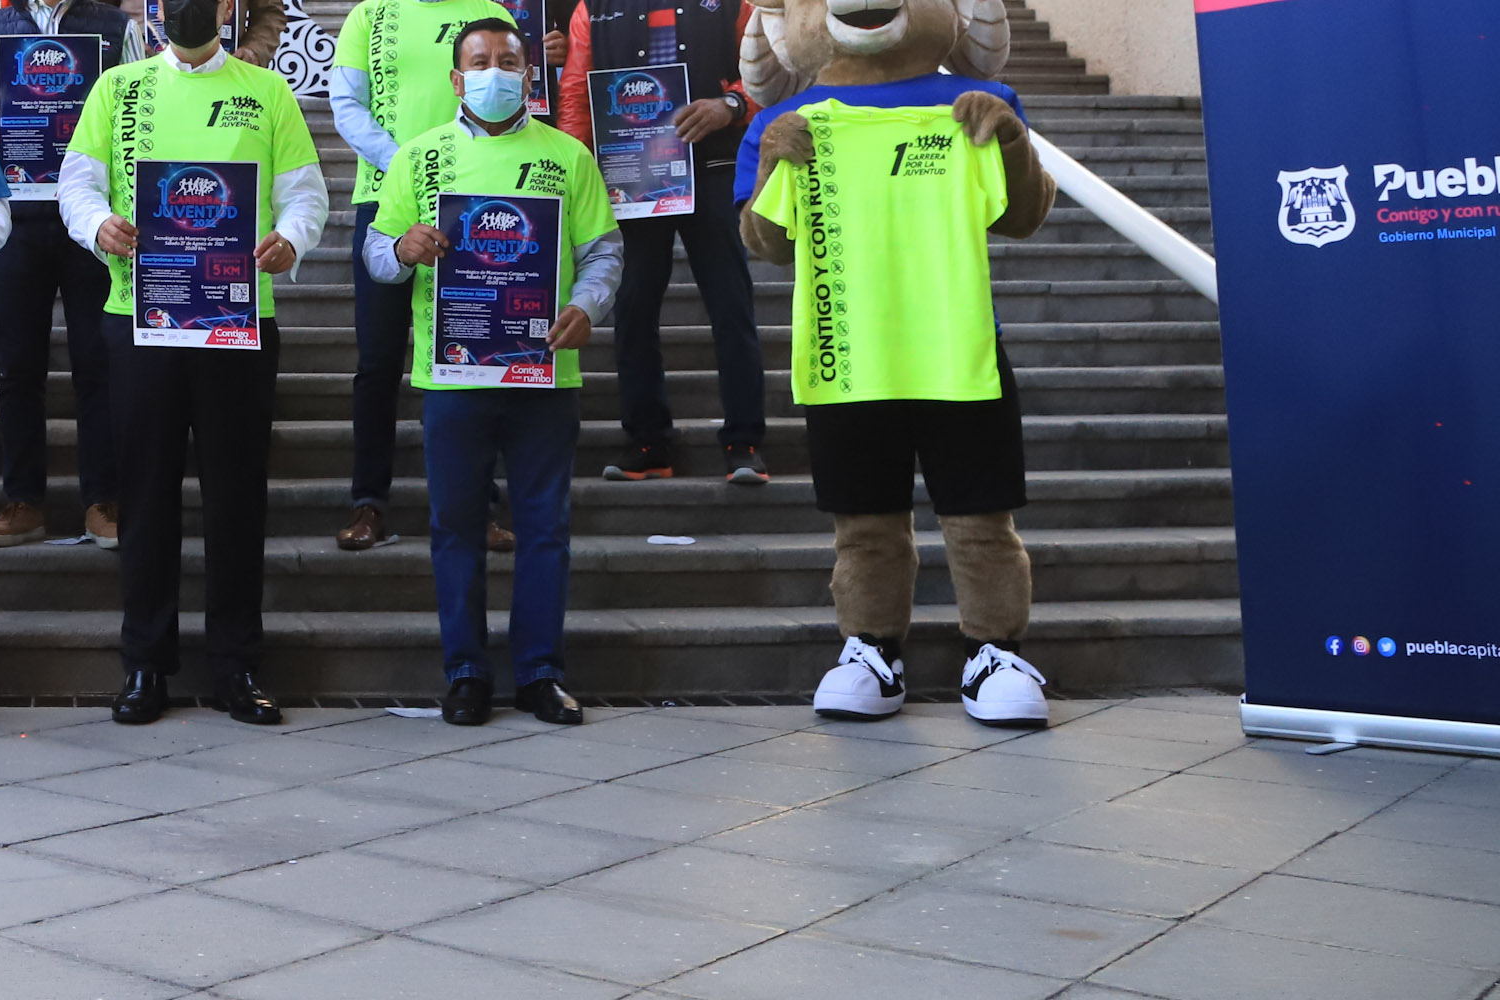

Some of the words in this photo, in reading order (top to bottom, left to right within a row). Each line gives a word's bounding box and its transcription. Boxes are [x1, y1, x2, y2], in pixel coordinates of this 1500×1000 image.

[11, 74, 84, 85] JUVENTUD
[373, 59, 384, 95] CON
[376, 99, 385, 110] Y
[607, 101, 673, 115] JUVENTUD
[223, 110, 259, 119] CARRERA
[220, 122, 260, 131] JUVENTUD
[532, 172, 565, 183] CARRERA
[903, 168, 946, 176] JUVENTUD
[528, 185, 565, 195] JUVENTUD
[168, 195, 219, 205] CARRERA
[153, 205, 238, 219] JUVENTUD
[1377, 207, 1438, 224] Contigo
[1442, 208, 1451, 222] y
[1454, 206, 1483, 218] con
[193, 219, 217, 228] 2022
[471, 230, 522, 239] CARRERA
[812, 212, 827, 259] CON
[1379, 232, 1434, 243] Gobierno
[1437, 226, 1496, 239] Municipal
[455, 239, 539, 254] JUVENTUD
[494, 254, 518, 262] 2022
[214, 264, 220, 275] 5
[224, 264, 240, 275] KM
[815, 266, 828, 279] Y
[513, 299, 521, 310] 5
[524, 301, 540, 311] KM
[215, 329, 248, 341] Contigo
[817, 284, 836, 382] CONTIGO
[228, 337, 256, 345] rumbo
[512, 365, 544, 377] Contigo
[524, 374, 551, 383] rumbo
